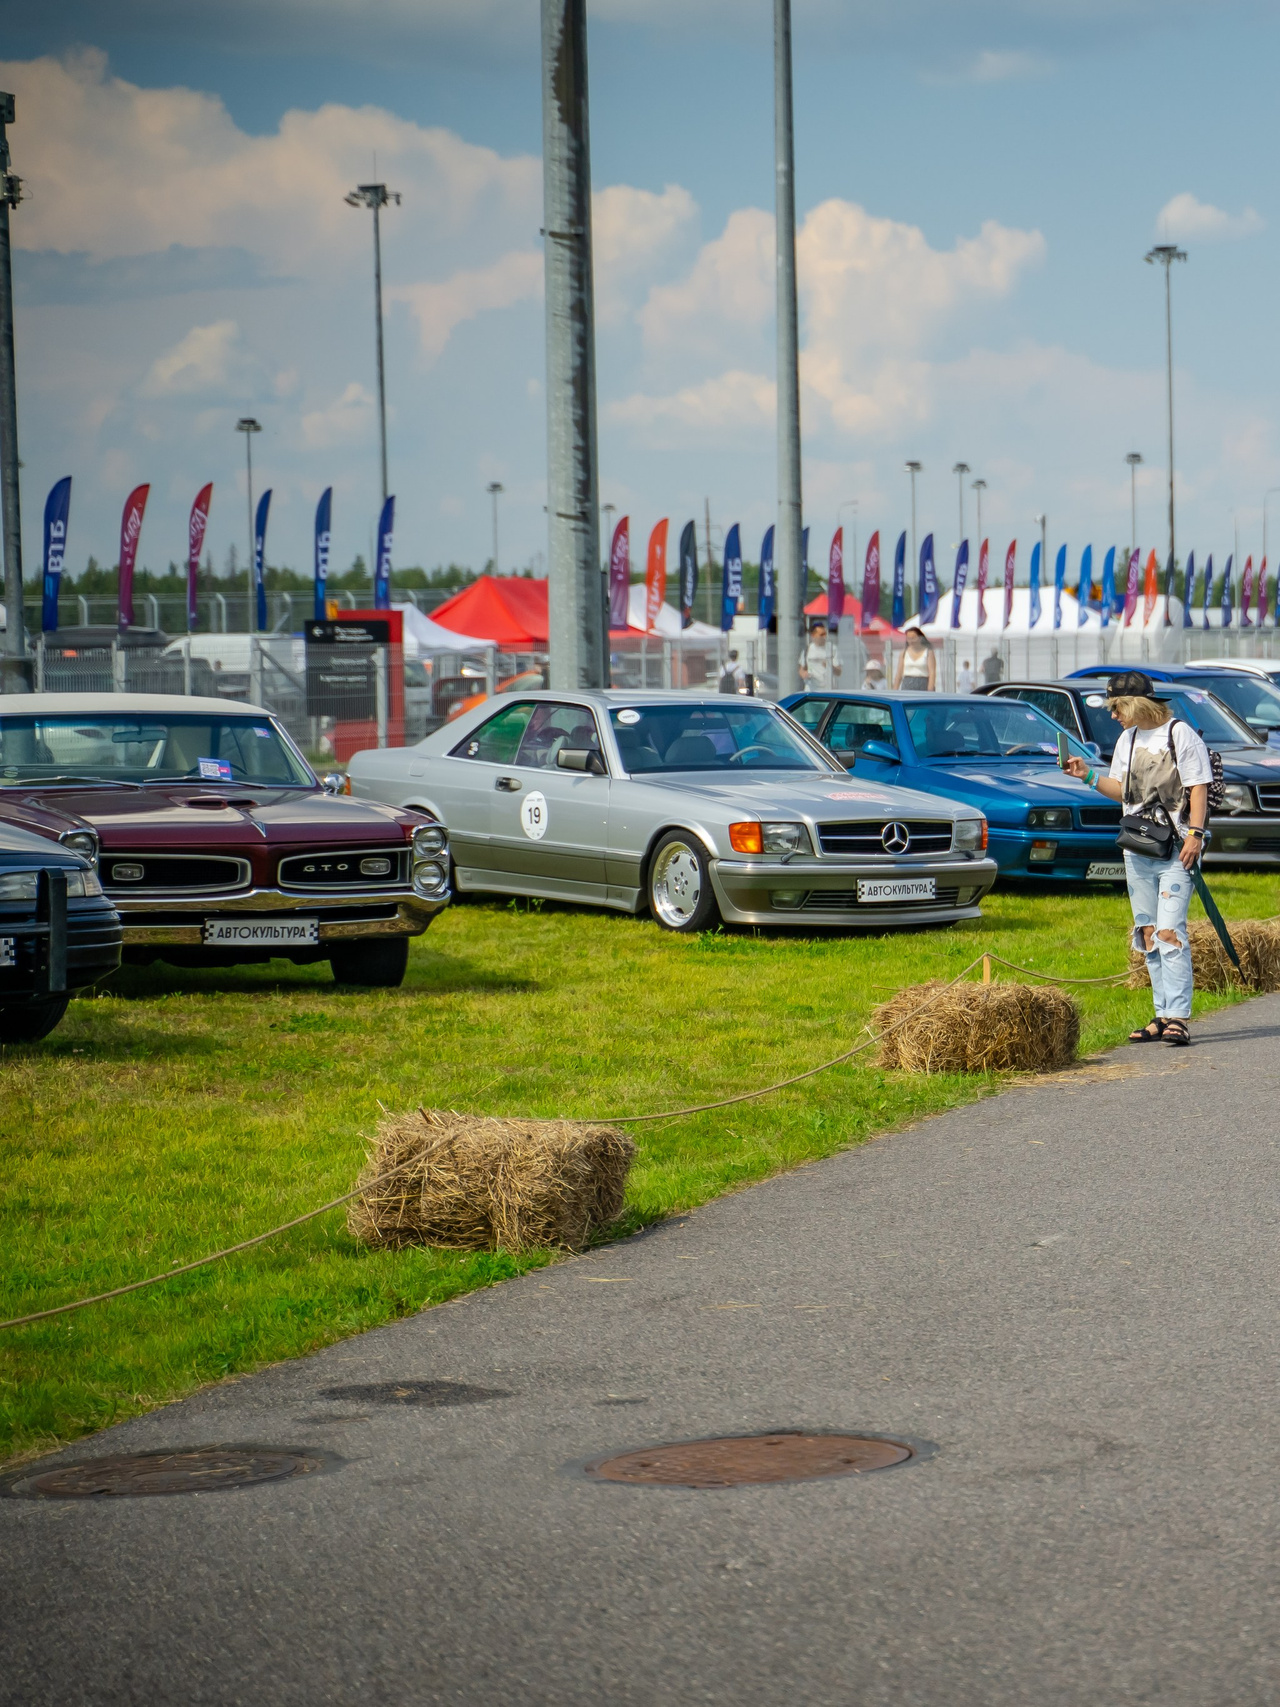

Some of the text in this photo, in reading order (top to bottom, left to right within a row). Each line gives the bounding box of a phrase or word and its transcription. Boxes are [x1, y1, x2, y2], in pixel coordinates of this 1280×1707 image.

[728, 558, 742, 597] ВТБ
[528, 806, 541, 825] 19
[303, 863, 348, 872] GTO
[867, 884, 928, 898] АВТОКУЛЬТУРА
[217, 925, 307, 940] АВТОКУЛЬТУРА
